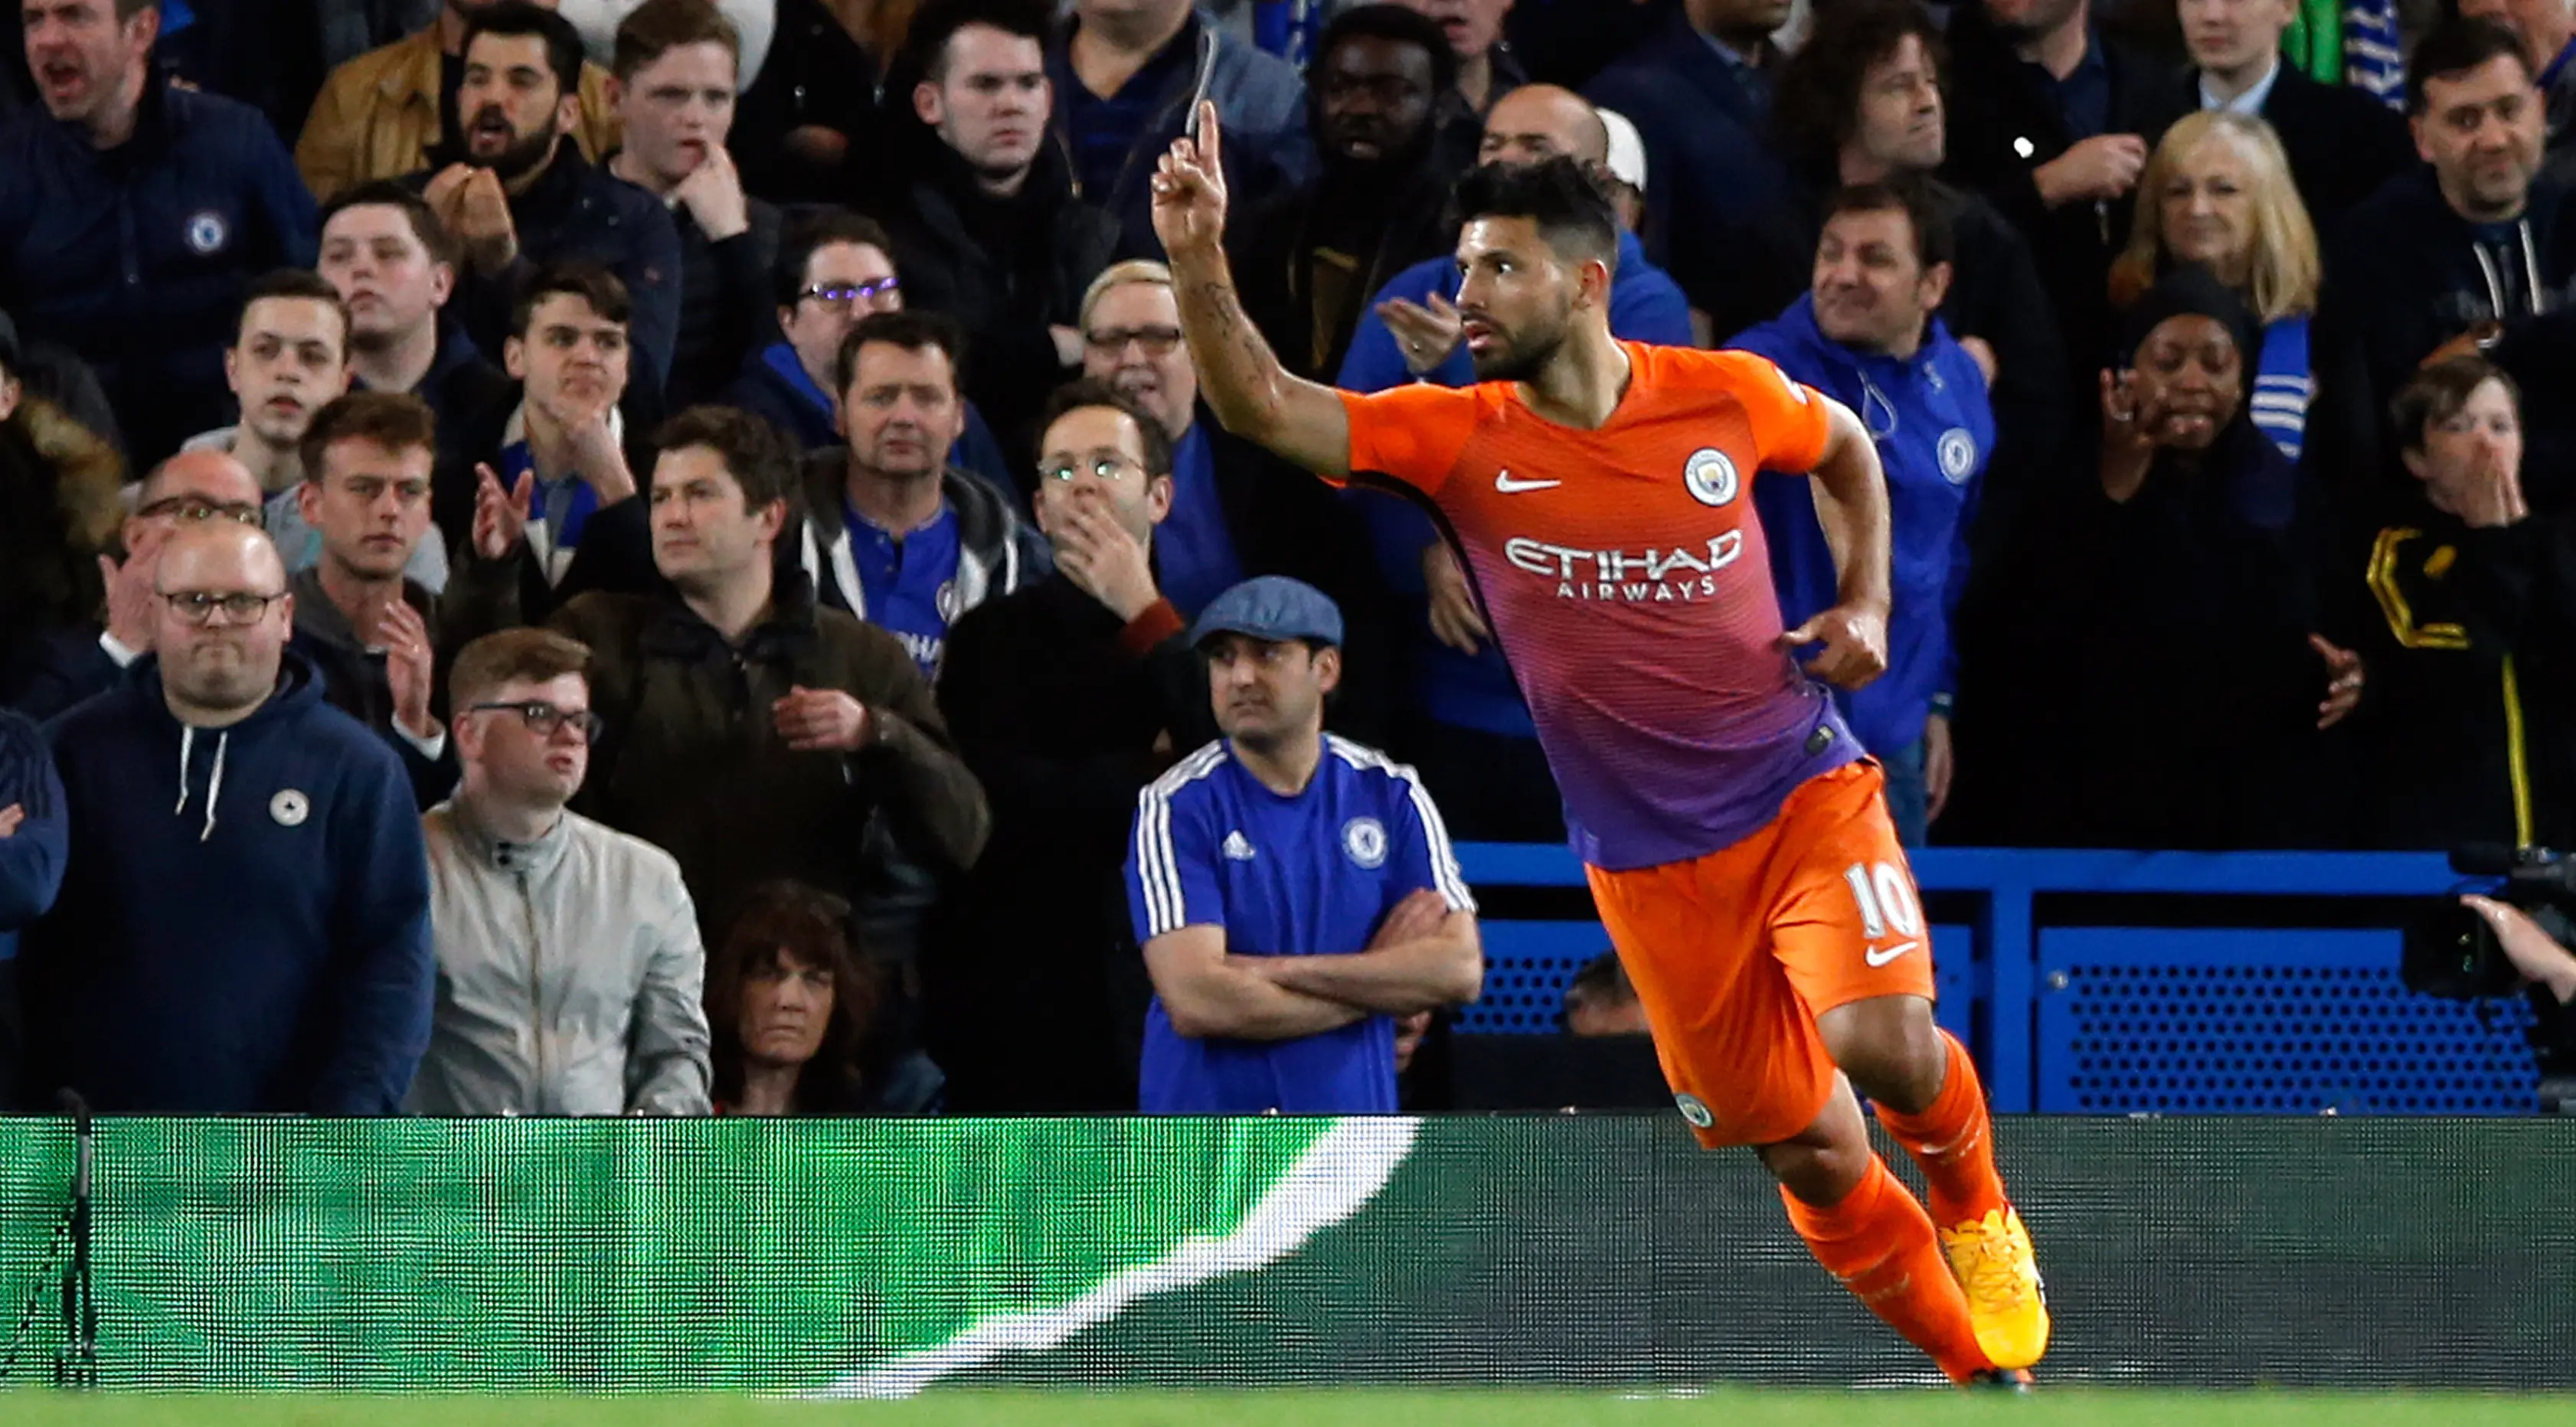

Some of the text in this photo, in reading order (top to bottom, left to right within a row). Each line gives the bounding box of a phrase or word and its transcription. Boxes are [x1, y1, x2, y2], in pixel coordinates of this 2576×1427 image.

[1505, 528, 1744, 580] ETIHAD
[1556, 575, 1718, 601] AIRWAYS
[1843, 861, 1921, 939] 10
